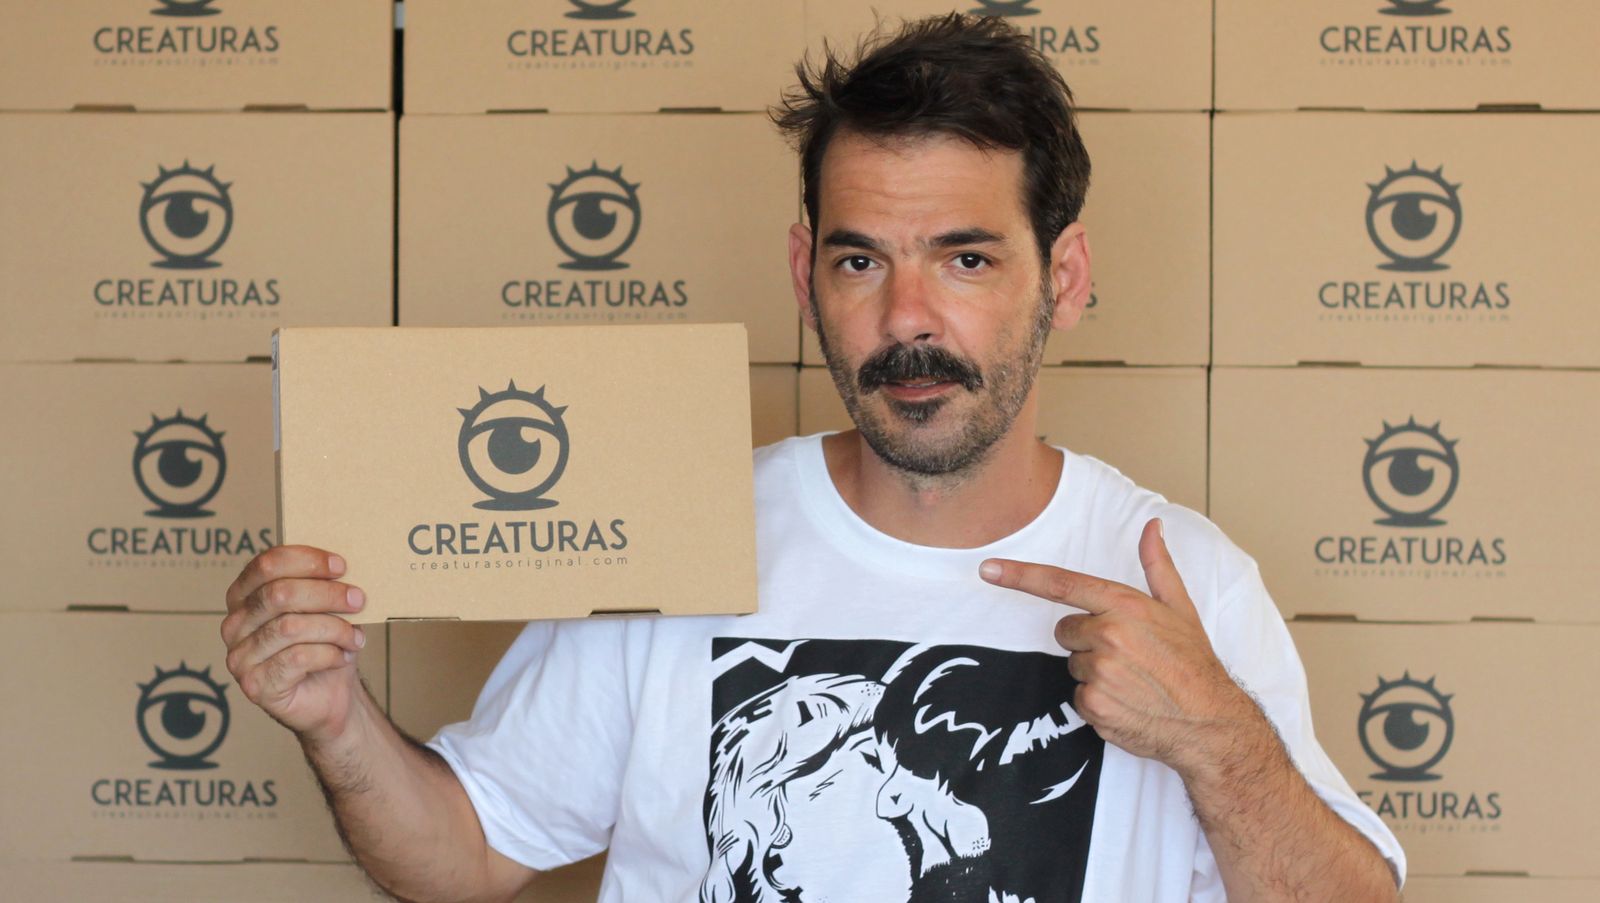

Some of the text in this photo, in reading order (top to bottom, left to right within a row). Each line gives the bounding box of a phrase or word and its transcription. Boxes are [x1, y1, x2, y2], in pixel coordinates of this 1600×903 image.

[93, 26, 280, 53] CREATURAS
[507, 29, 694, 57] CREATURAS
[1319, 25, 1512, 53] CREATURAS
[93, 279, 280, 306] CREATURAS
[501, 280, 688, 308] CREATURAS
[1318, 282, 1510, 310] CREATURAS
[87, 528, 273, 555] CREATURAS
[407, 518, 628, 555] CREATURAS
[1314, 536, 1507, 565] CREATURAS
[409, 556, 628, 570] creaturasoriginal.com
[91, 779, 278, 807] CREATURAS
[1357, 791, 1502, 819] ATURAS
